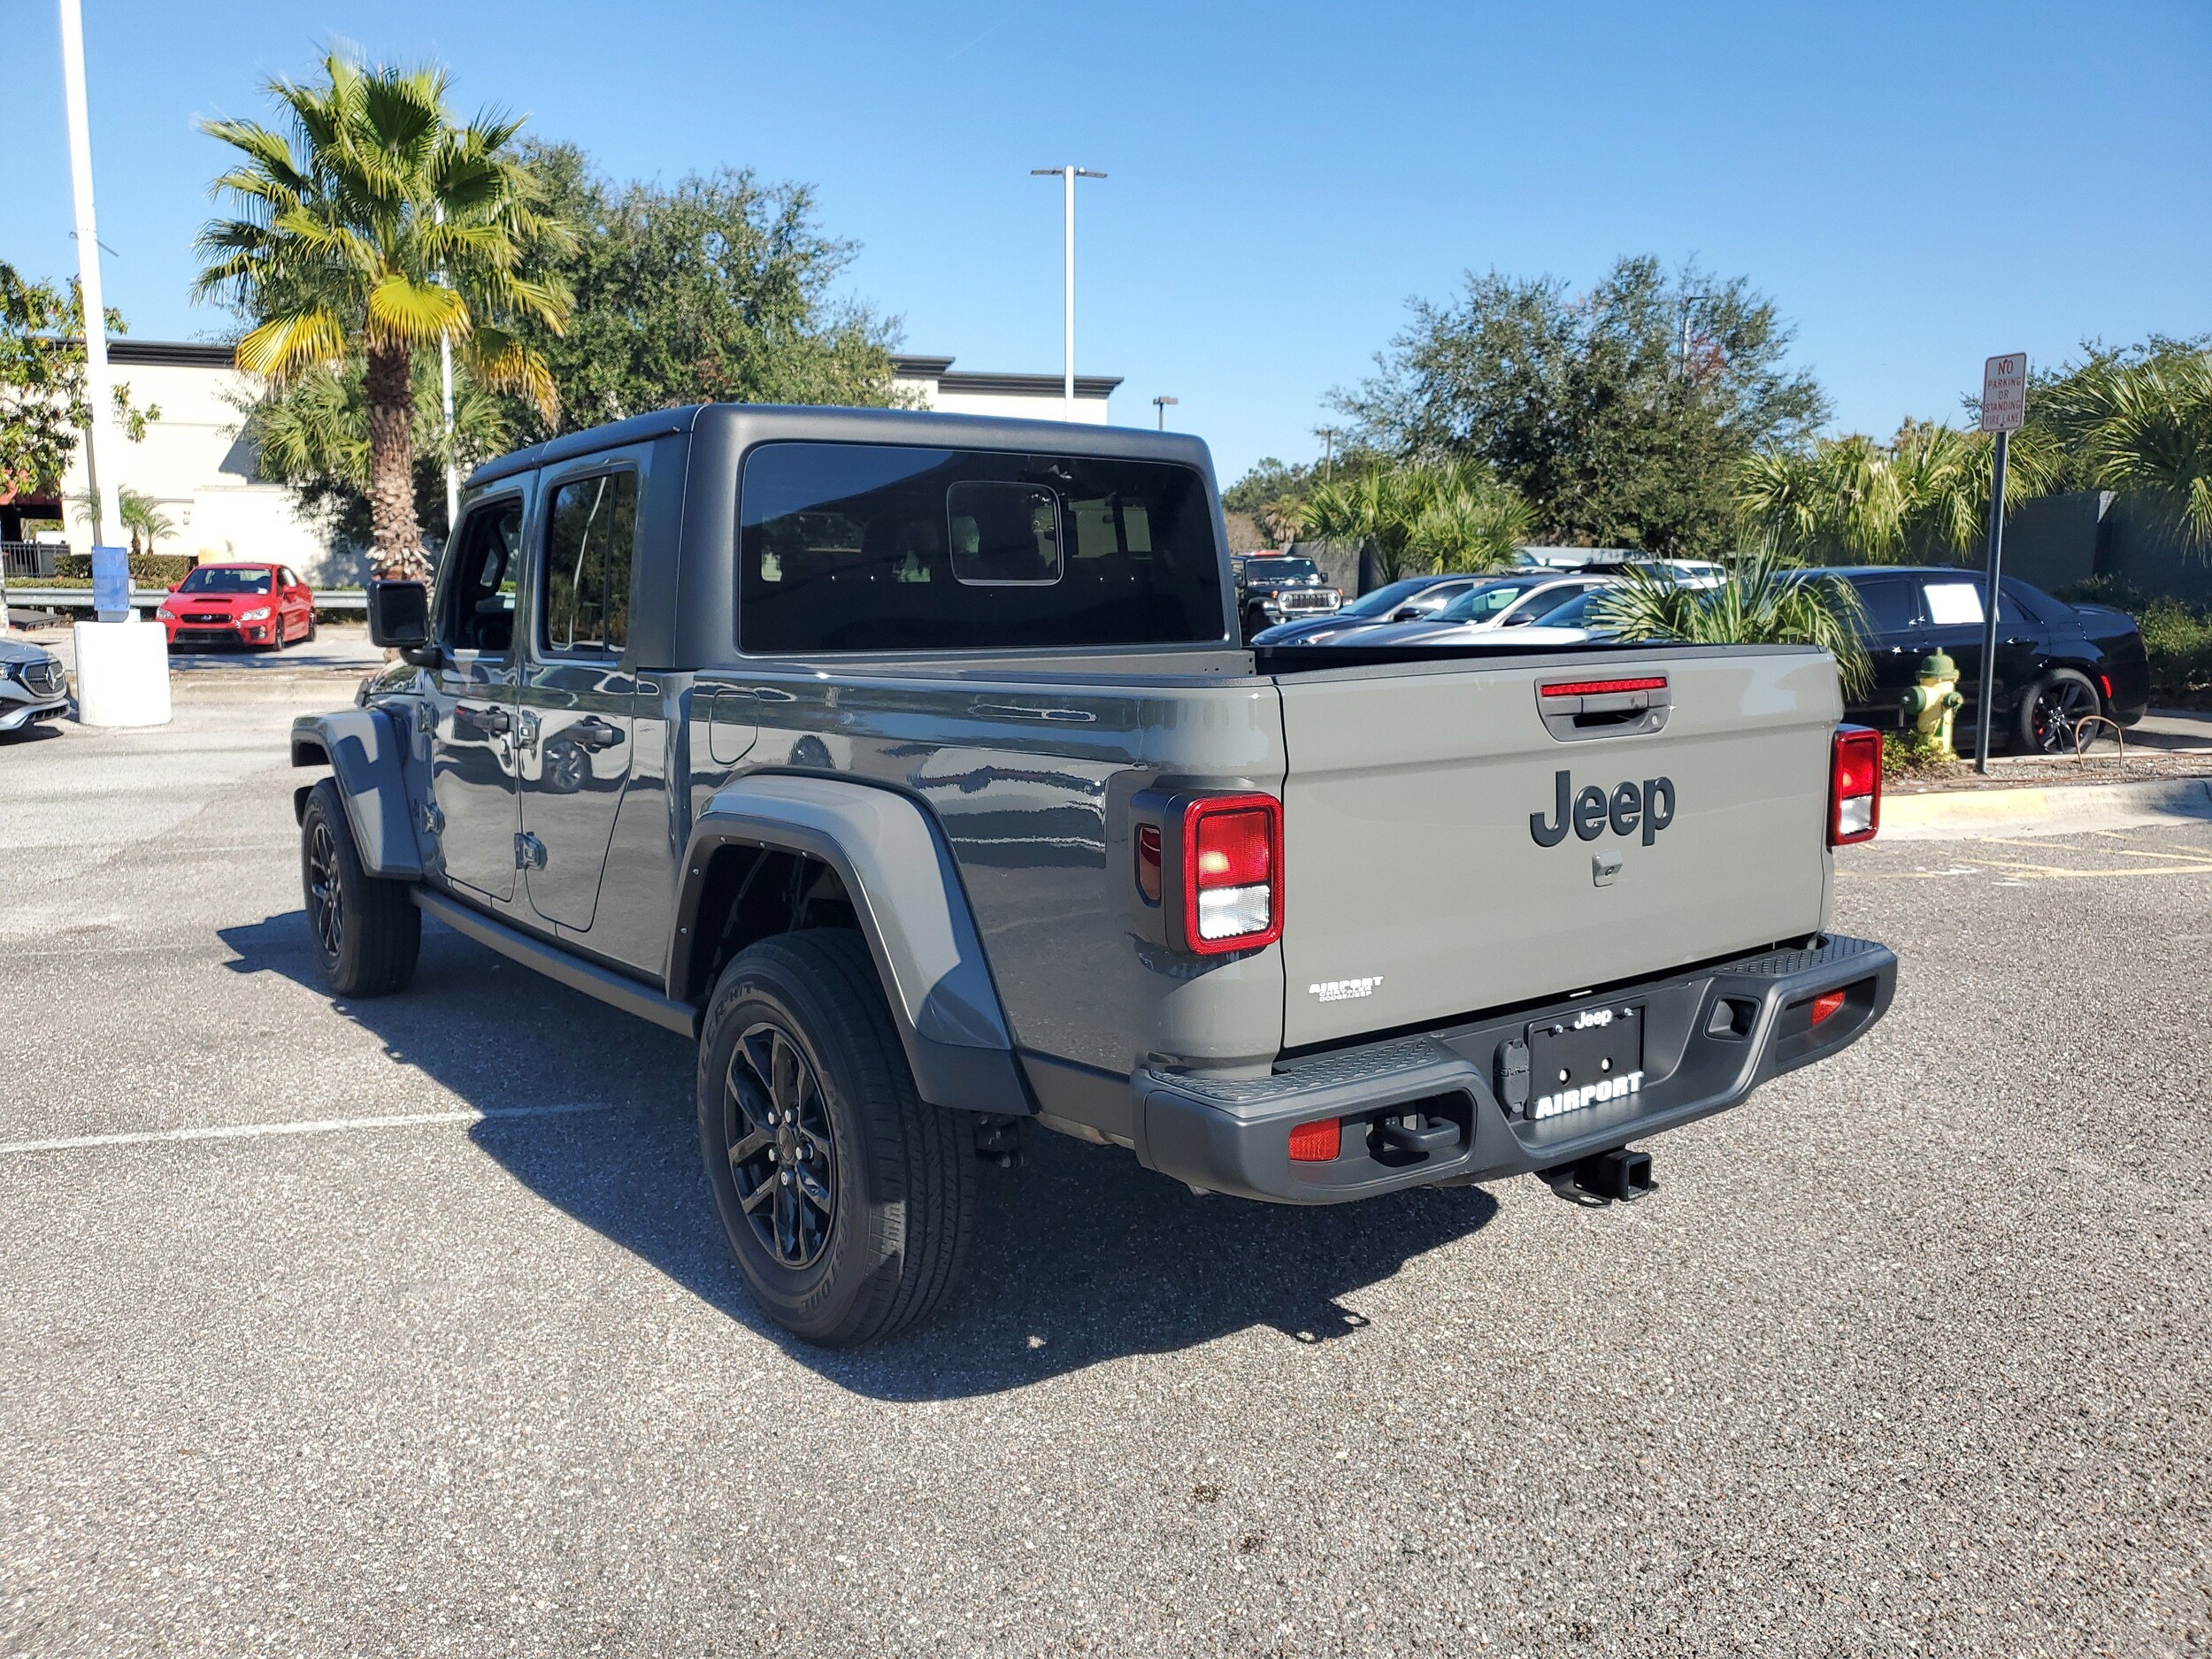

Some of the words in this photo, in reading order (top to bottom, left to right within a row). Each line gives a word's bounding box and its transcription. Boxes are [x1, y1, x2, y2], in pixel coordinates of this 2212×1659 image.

[1998, 360, 2014, 375] NO
[1988, 377, 2022, 389] PARKING
[1998, 390, 2008, 400] OR
[1985, 400, 2021, 413] STANDING
[1985, 415, 1999, 425] FIRE
[2002, 413, 2018, 424] LANE
[1530, 770, 1676, 848] Jeep
[1309, 976, 1383, 994] AIRPORT
[1574, 1010, 1613, 1029] Jeep
[1535, 1071, 1644, 1120] AIRPORT
